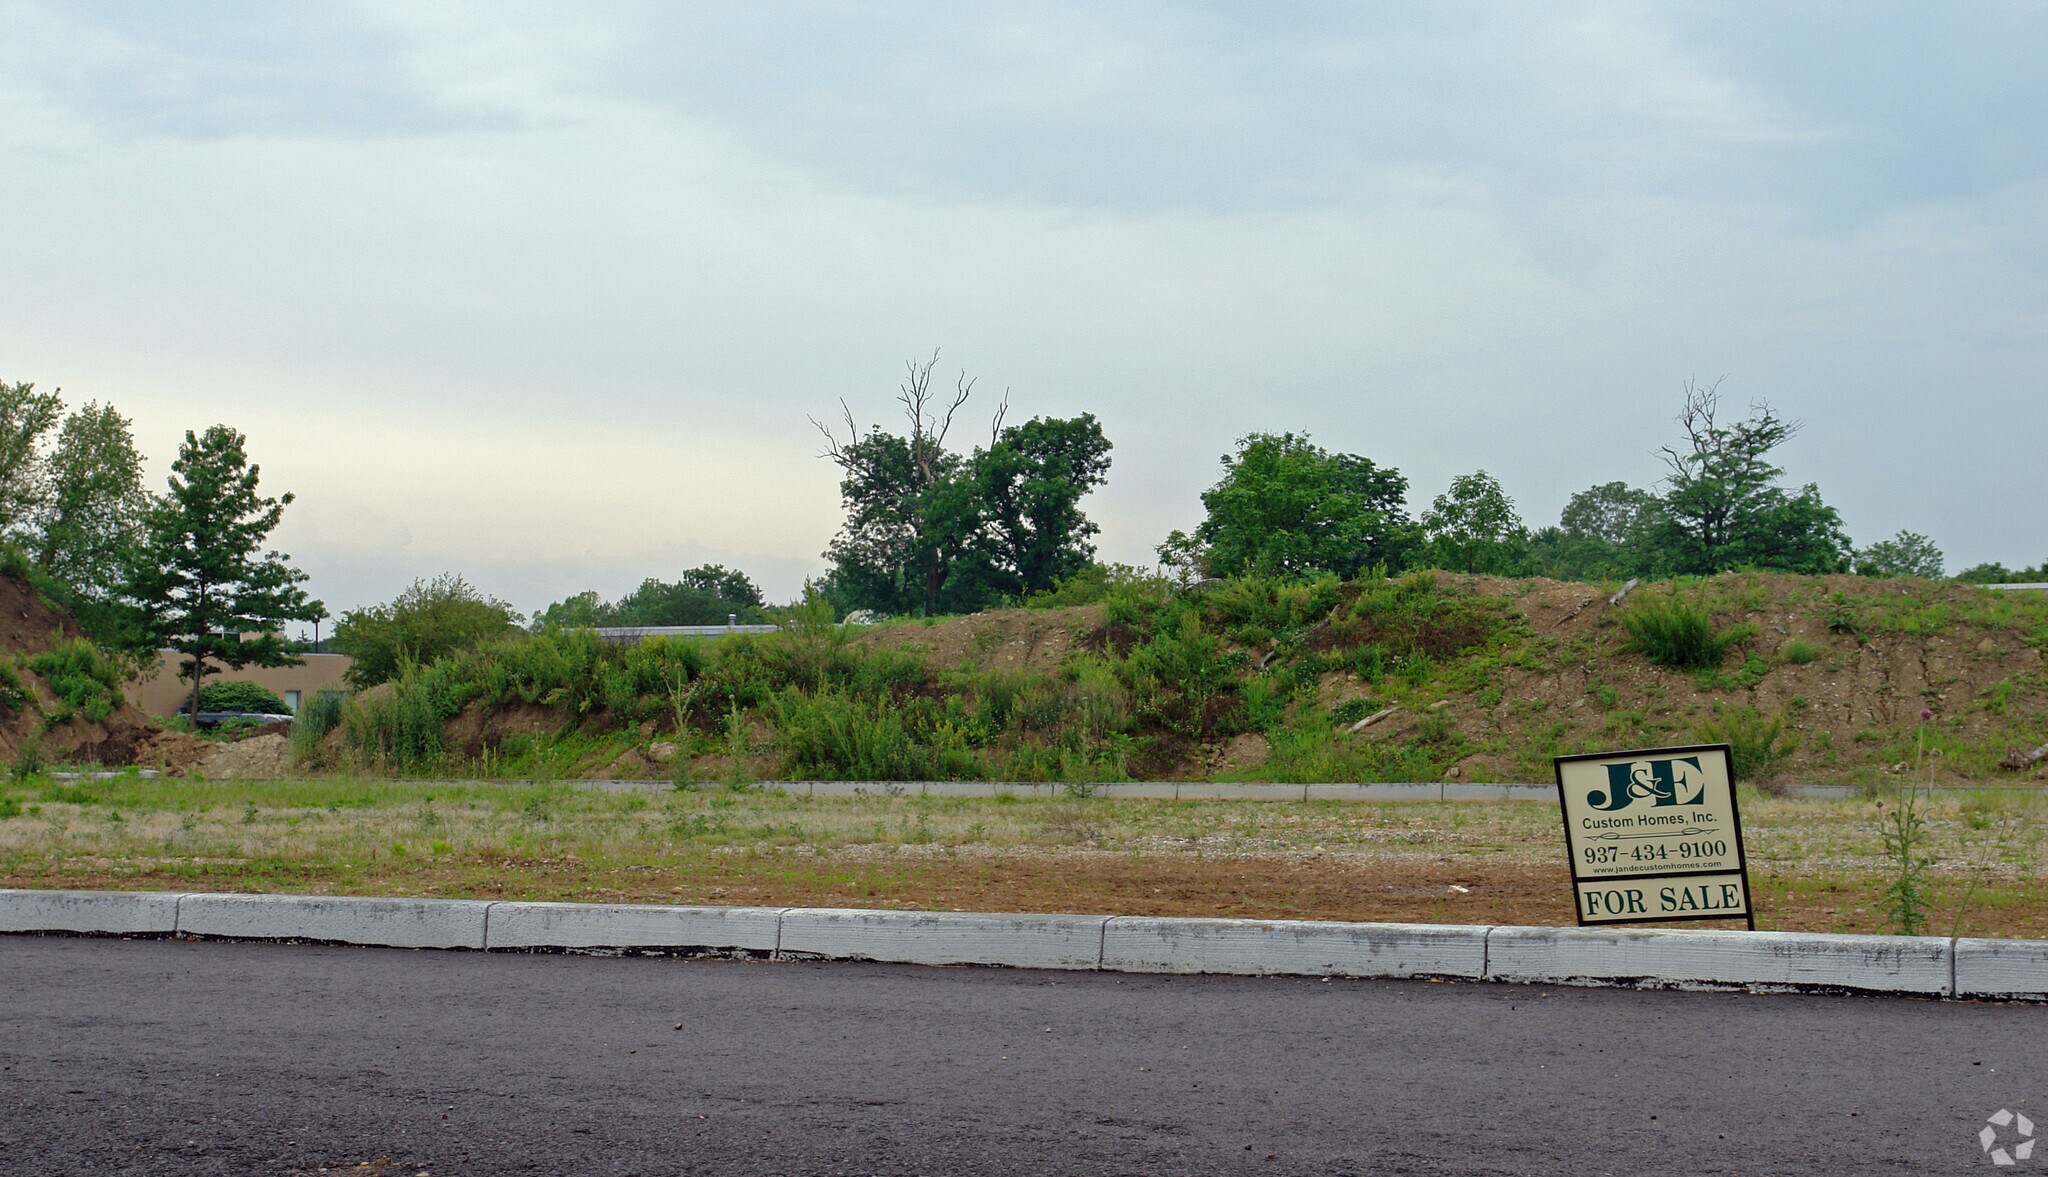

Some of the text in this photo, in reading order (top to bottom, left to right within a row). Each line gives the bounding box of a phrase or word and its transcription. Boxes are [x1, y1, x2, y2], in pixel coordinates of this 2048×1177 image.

[1587, 756, 1705, 811] J&E
[1582, 811, 1717, 829] Custom Homes, Inc.
[1584, 840, 1727, 864] 937-434-9100
[1593, 860, 1722, 874] www.jandecustomhomes.com
[1584, 883, 1741, 916] FOR SALE
